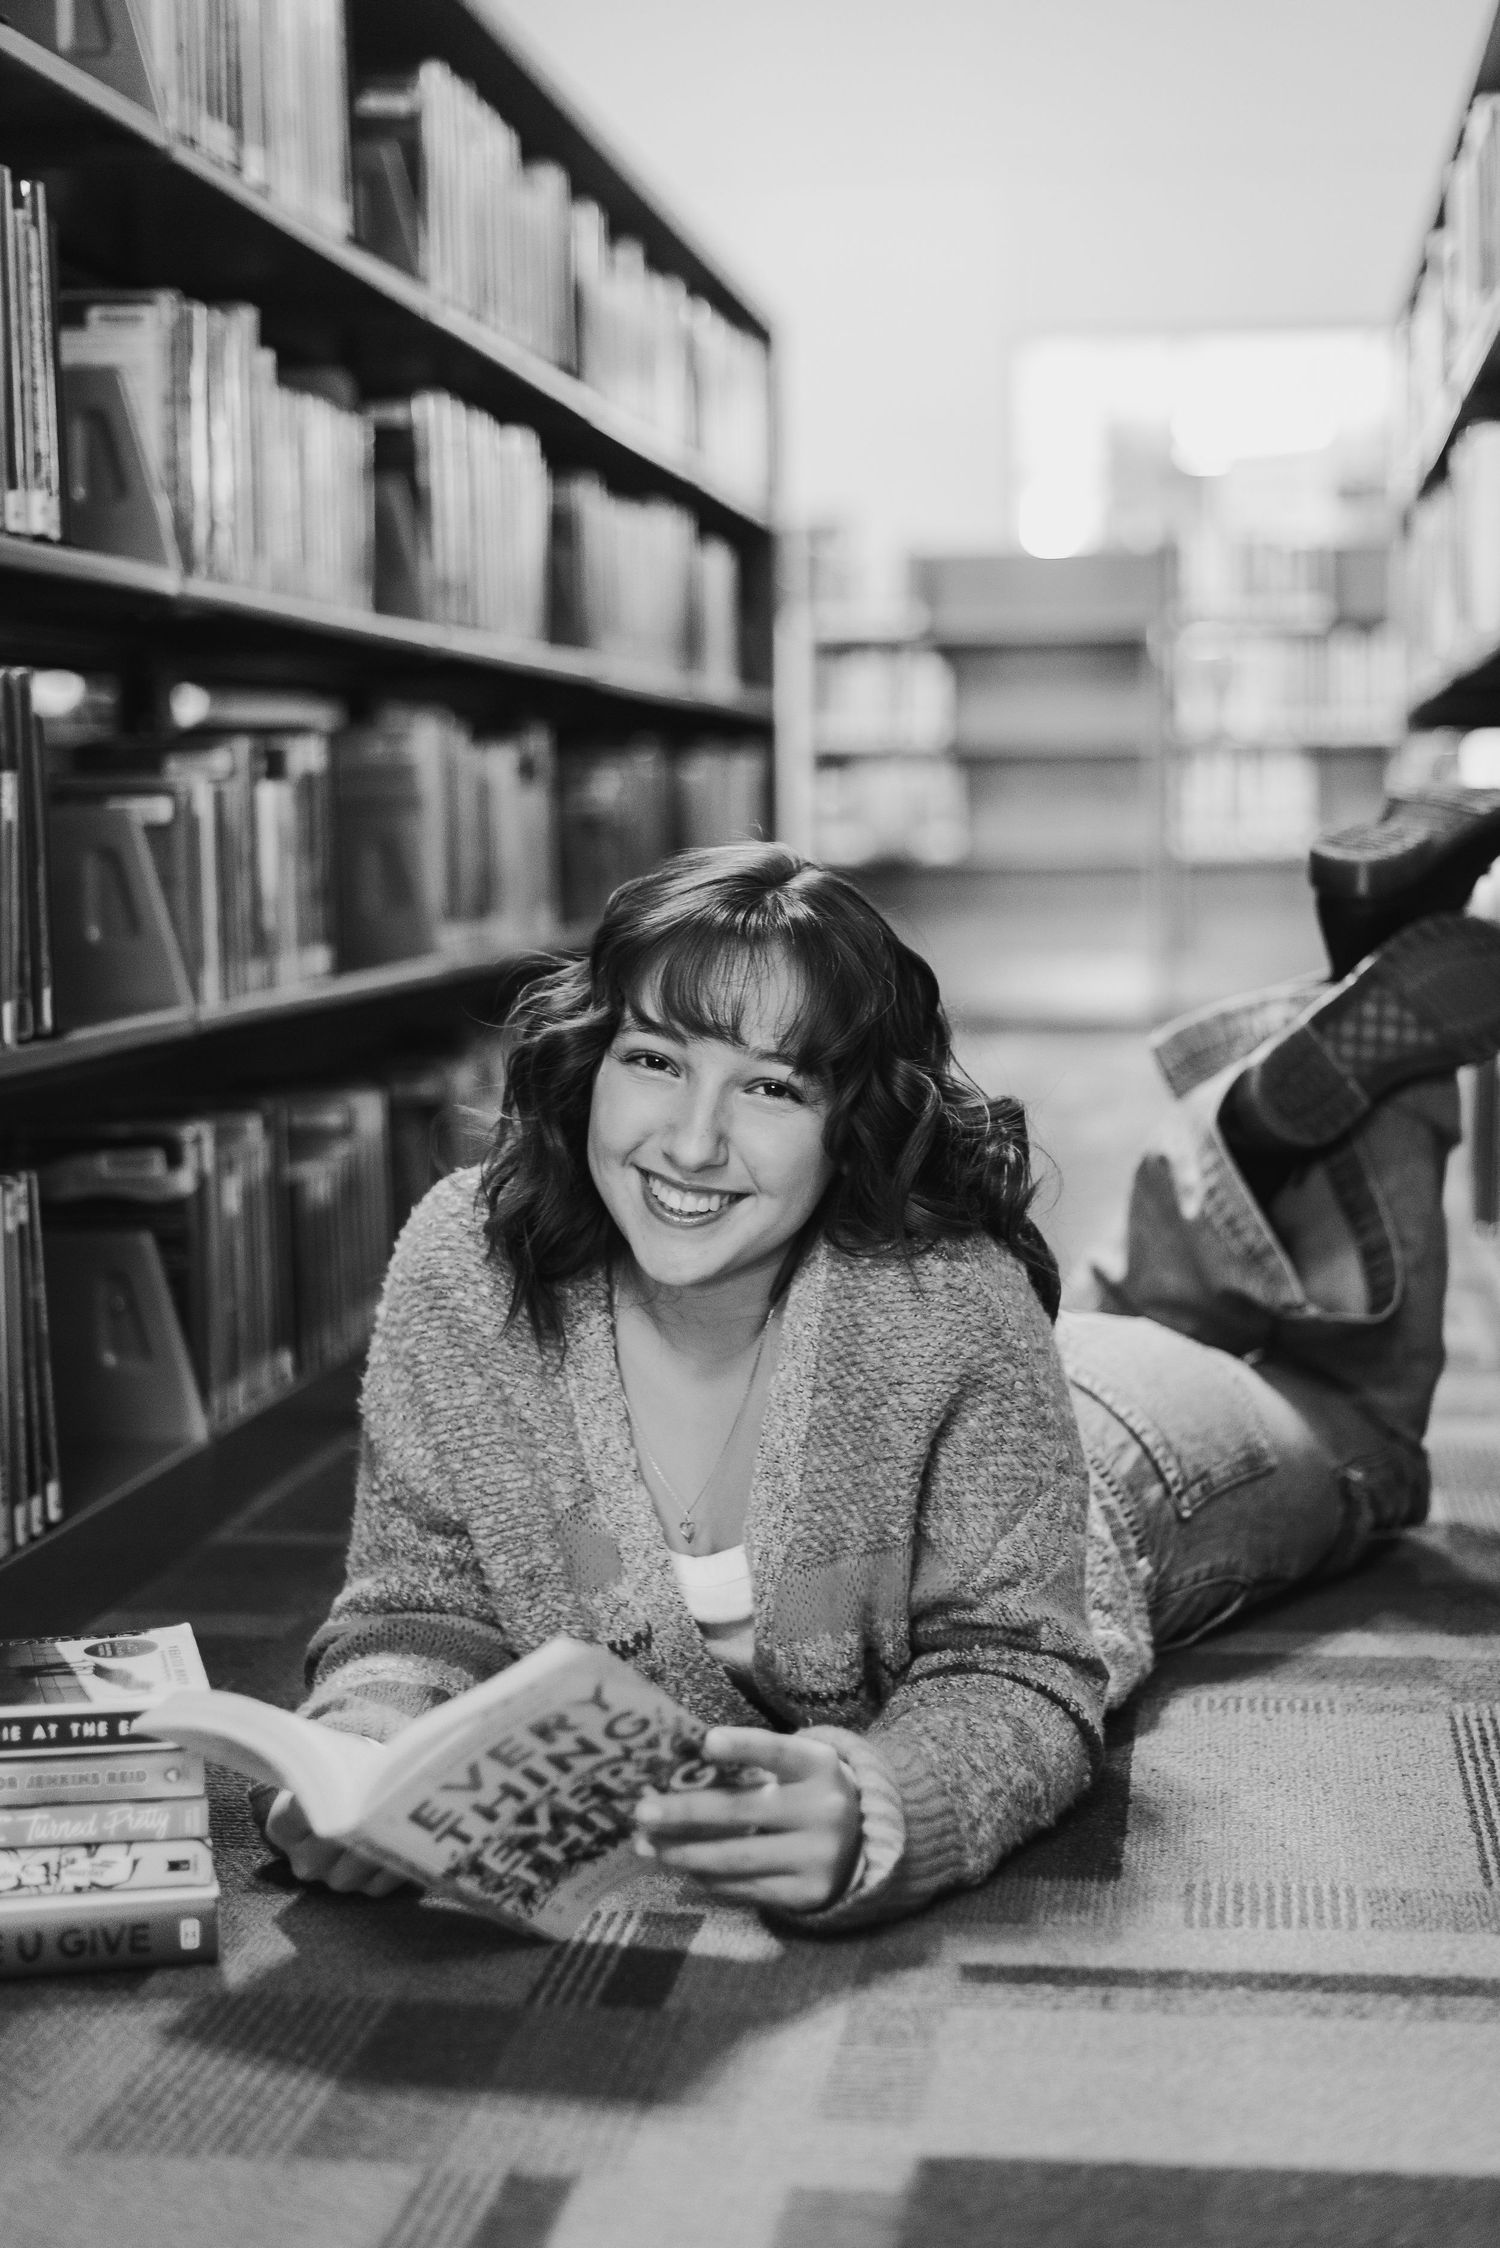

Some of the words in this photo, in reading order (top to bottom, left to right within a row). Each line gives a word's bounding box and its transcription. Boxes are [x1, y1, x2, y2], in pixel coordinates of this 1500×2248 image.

[32, 1722, 58, 1741] AT
[69, 1720, 109, 1738] THE
[118, 1719, 134, 1737] E
[408, 1684, 609, 1833] EVERY
[435, 1711, 650, 1845] THING
[26, 1771, 100, 1789] JENKINS
[106, 1769, 148, 1785] REID
[16, 1811, 98, 1843] Turned
[103, 1806, 170, 1840] Pretty
[16, 1930, 44, 1964] U
[56, 1922, 152, 1959] GIVE
